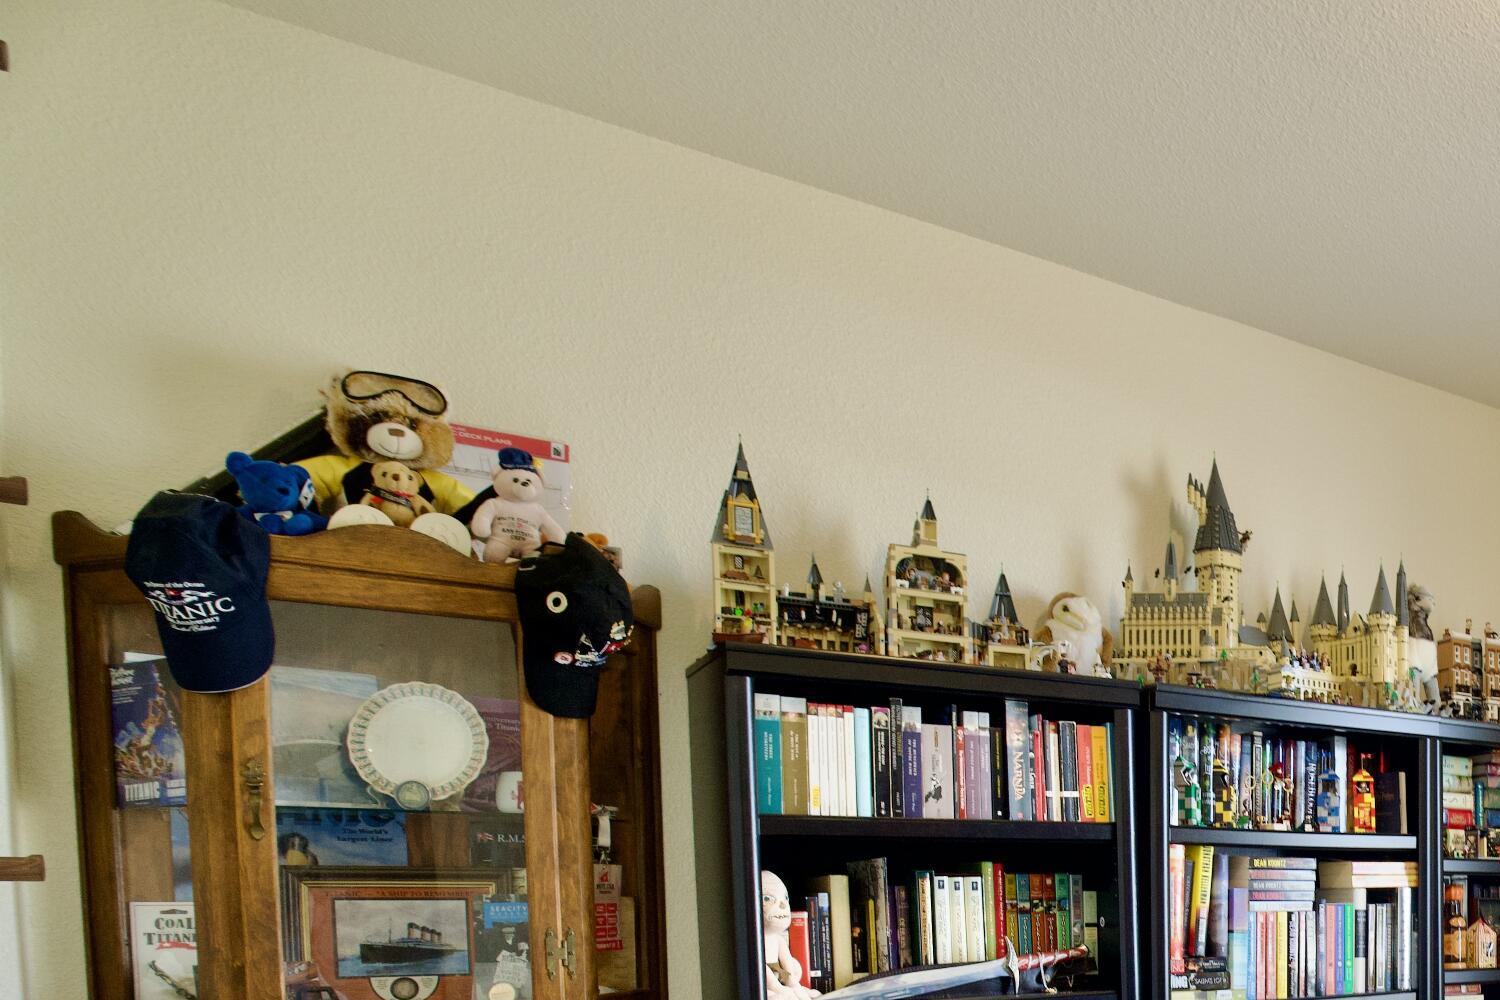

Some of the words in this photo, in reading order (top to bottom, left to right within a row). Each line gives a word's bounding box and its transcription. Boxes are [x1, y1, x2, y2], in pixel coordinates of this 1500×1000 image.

[144, 596, 236, 620] TITANIC
[1012, 750, 1026, 801] NARNIA
[124, 780, 160, 802] TITANIC
[1253, 858, 1267, 868] DEAN
[489, 905, 528, 913] SEACITY
